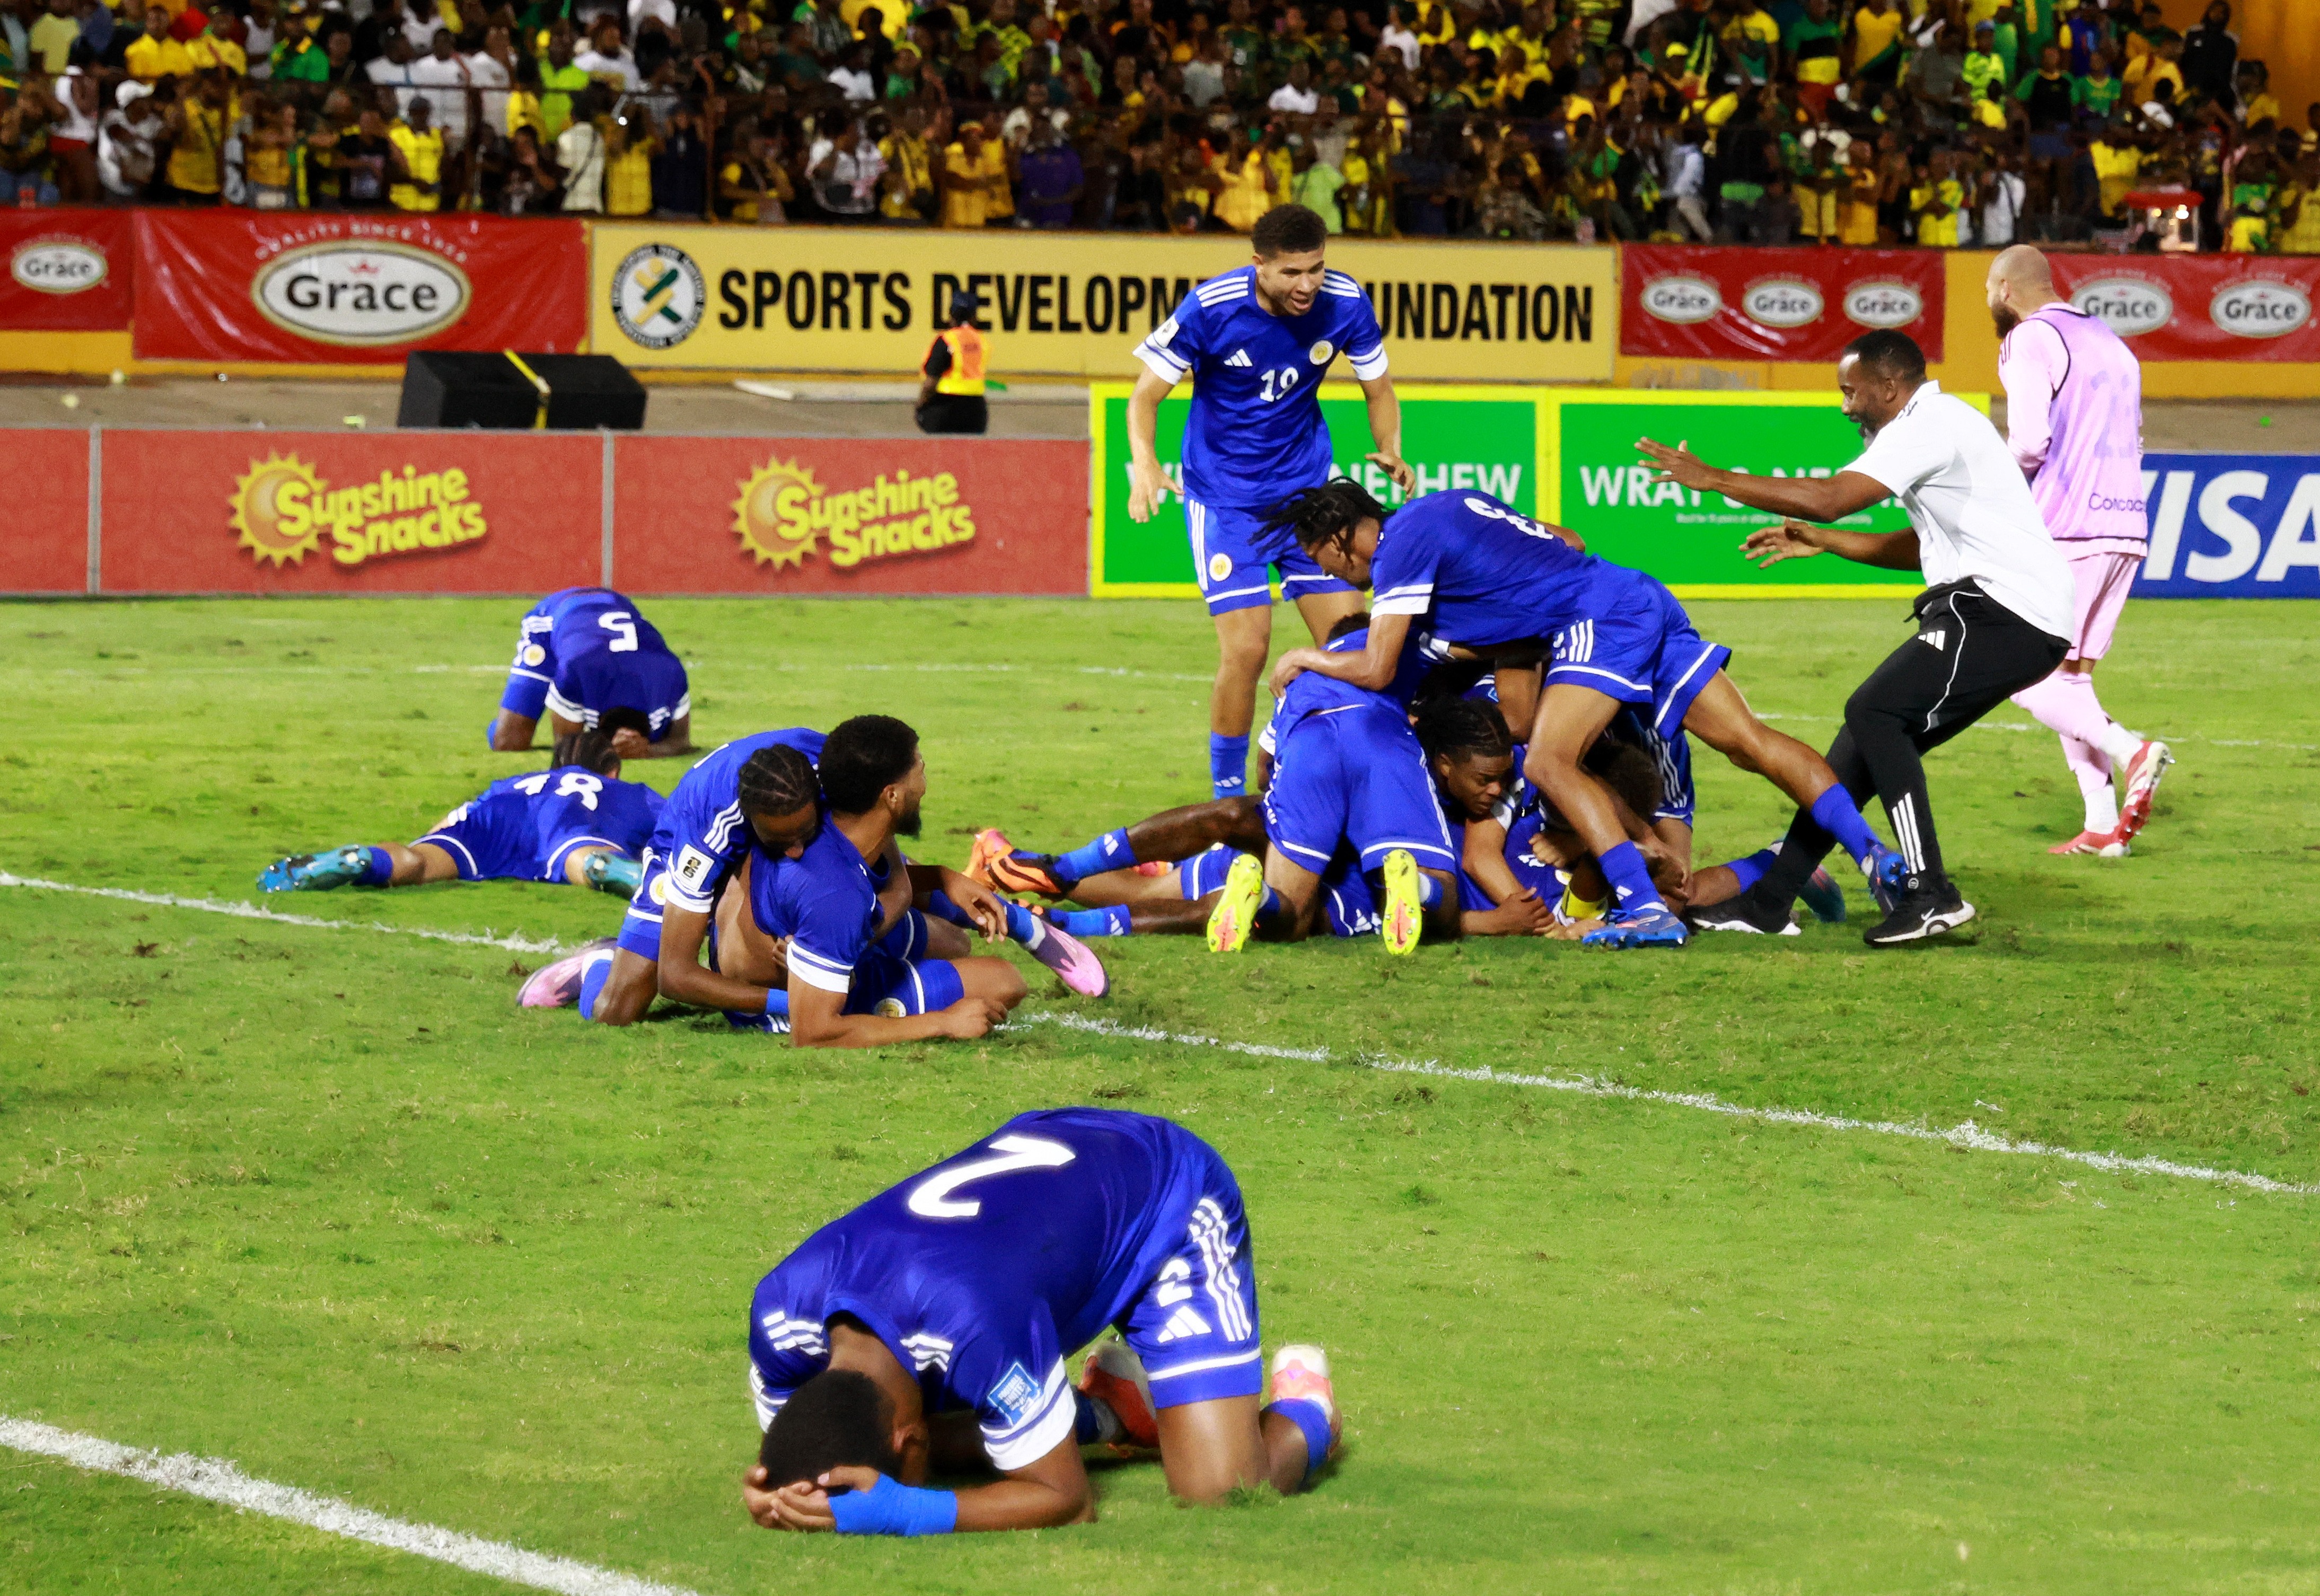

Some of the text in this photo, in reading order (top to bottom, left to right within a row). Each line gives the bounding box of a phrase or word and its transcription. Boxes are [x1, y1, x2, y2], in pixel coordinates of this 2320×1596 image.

[286, 275, 437, 312] Grace
[719, 270, 911, 331] SPORTS
[933, 274, 1210, 332] DEVELOPM
[1366, 283, 1593, 341] UNDATION
[1653, 289, 1710, 310] Grace
[1754, 294, 1811, 313] Grace
[1855, 296, 1910, 314] Grace
[2084, 295, 2158, 319] Grace
[2226, 298, 2298, 320] Grace
[1259, 367, 1299, 402] 19
[276, 464, 470, 536] Sunshine
[776, 469, 960, 541] Sunshine
[332, 501, 487, 565] Snacks
[829, 505, 976, 567] Snacks
[2142, 469, 2320, 584] ISA
[599, 611, 638, 652] 5
[1156, 1258, 1193, 1307] 2
